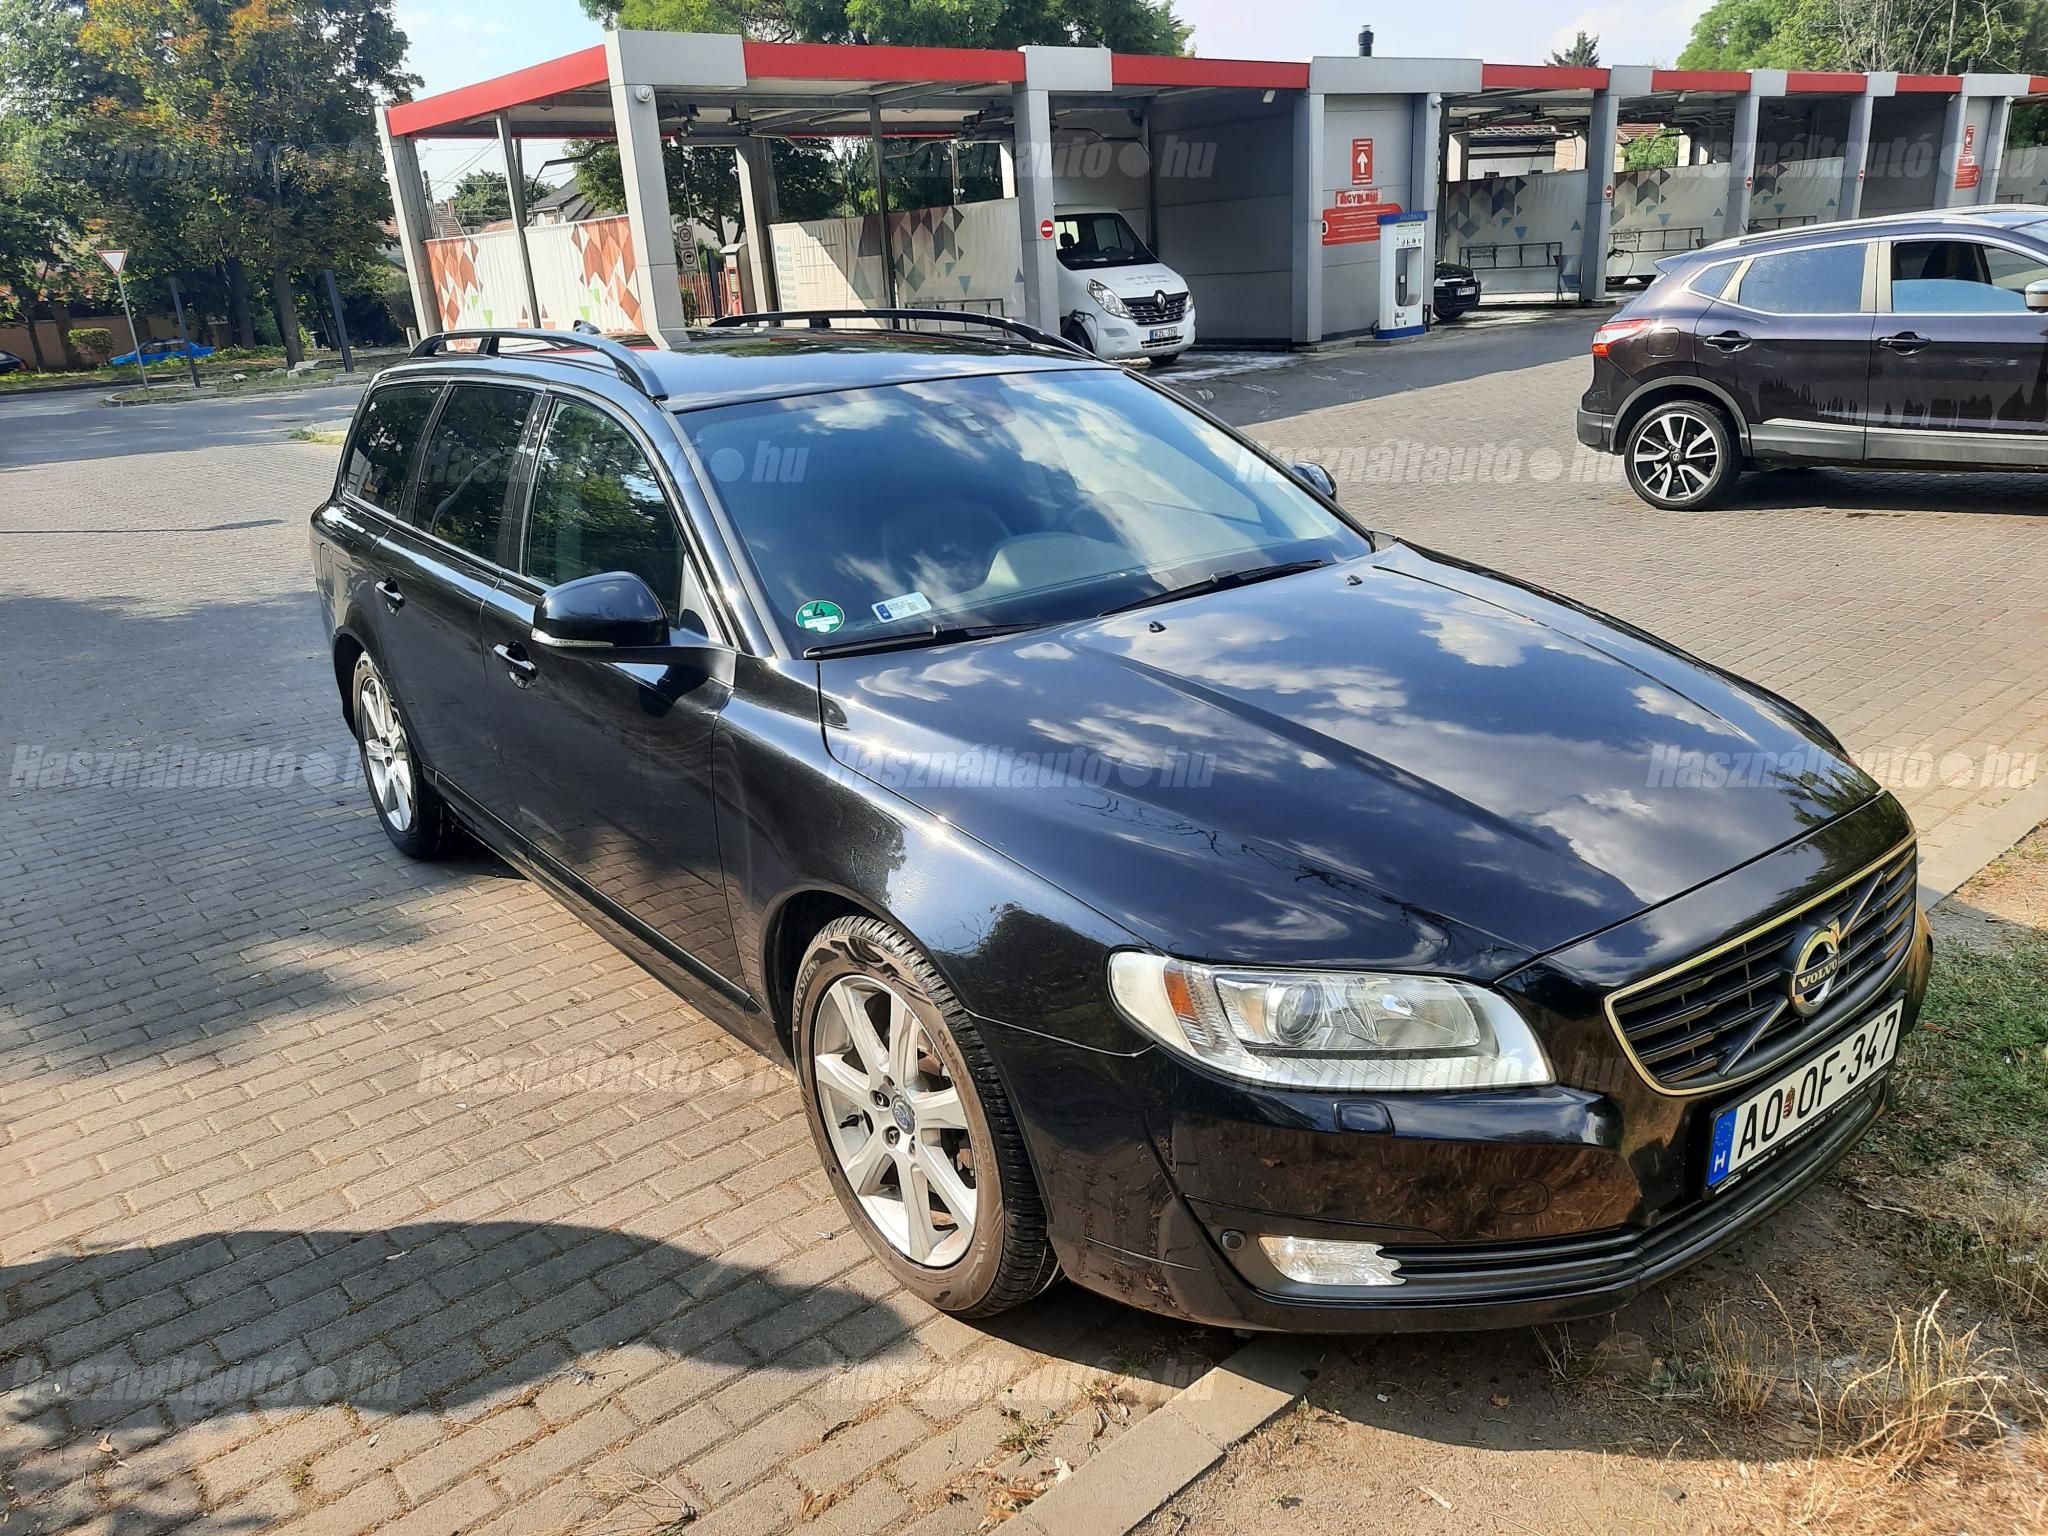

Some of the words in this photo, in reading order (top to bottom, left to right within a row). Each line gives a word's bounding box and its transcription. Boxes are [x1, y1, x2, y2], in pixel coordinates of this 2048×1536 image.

[812, 602, 826, 617] 4
[1799, 959, 1838, 988] VOLVO
[793, 960, 818, 1032] VREDESTEIN
[1796, 1012, 1897, 1120] OF-347
[1714, 1151, 1726, 1173] H
